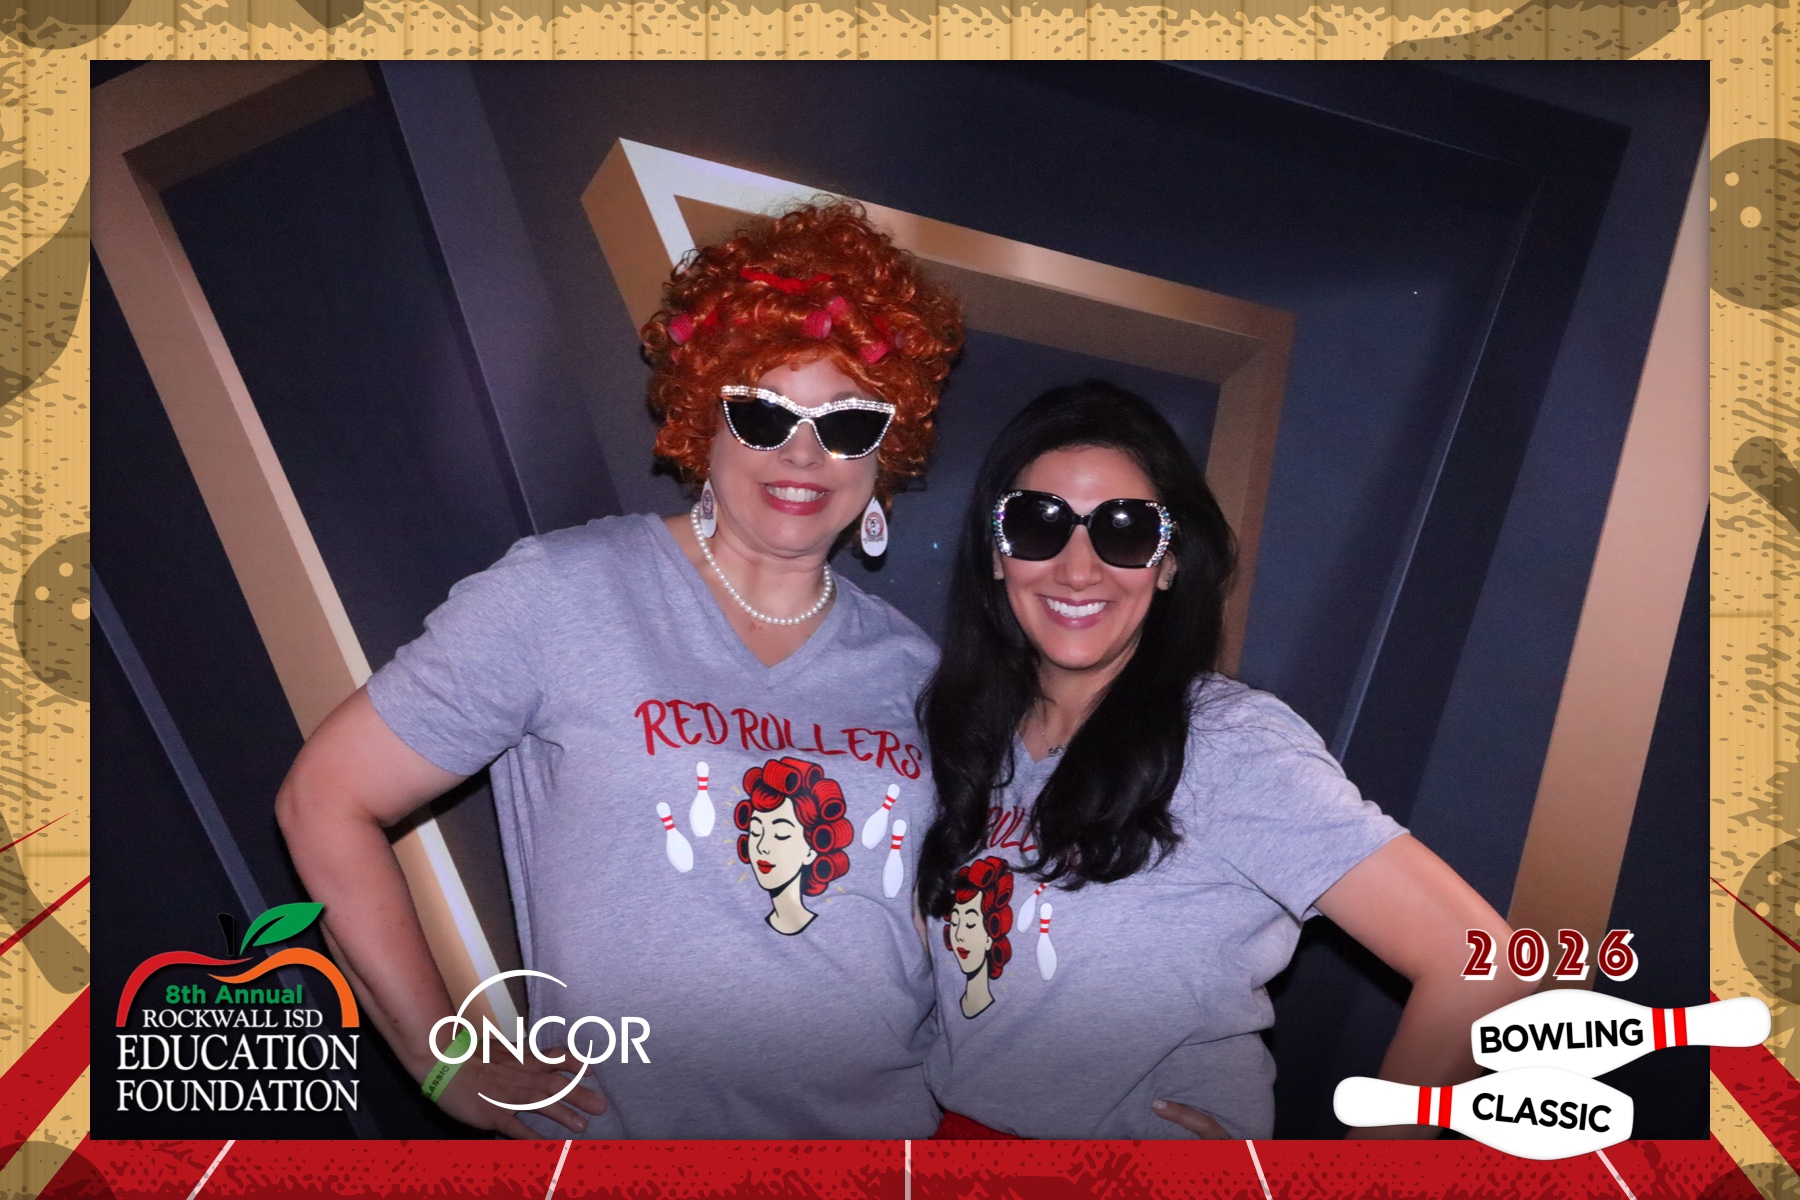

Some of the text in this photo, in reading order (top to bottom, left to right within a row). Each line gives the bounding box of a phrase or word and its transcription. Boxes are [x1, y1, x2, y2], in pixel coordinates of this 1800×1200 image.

[634, 699, 923, 779] RED ROLLERS
[426, 1065, 450, 1096] LASSIC
